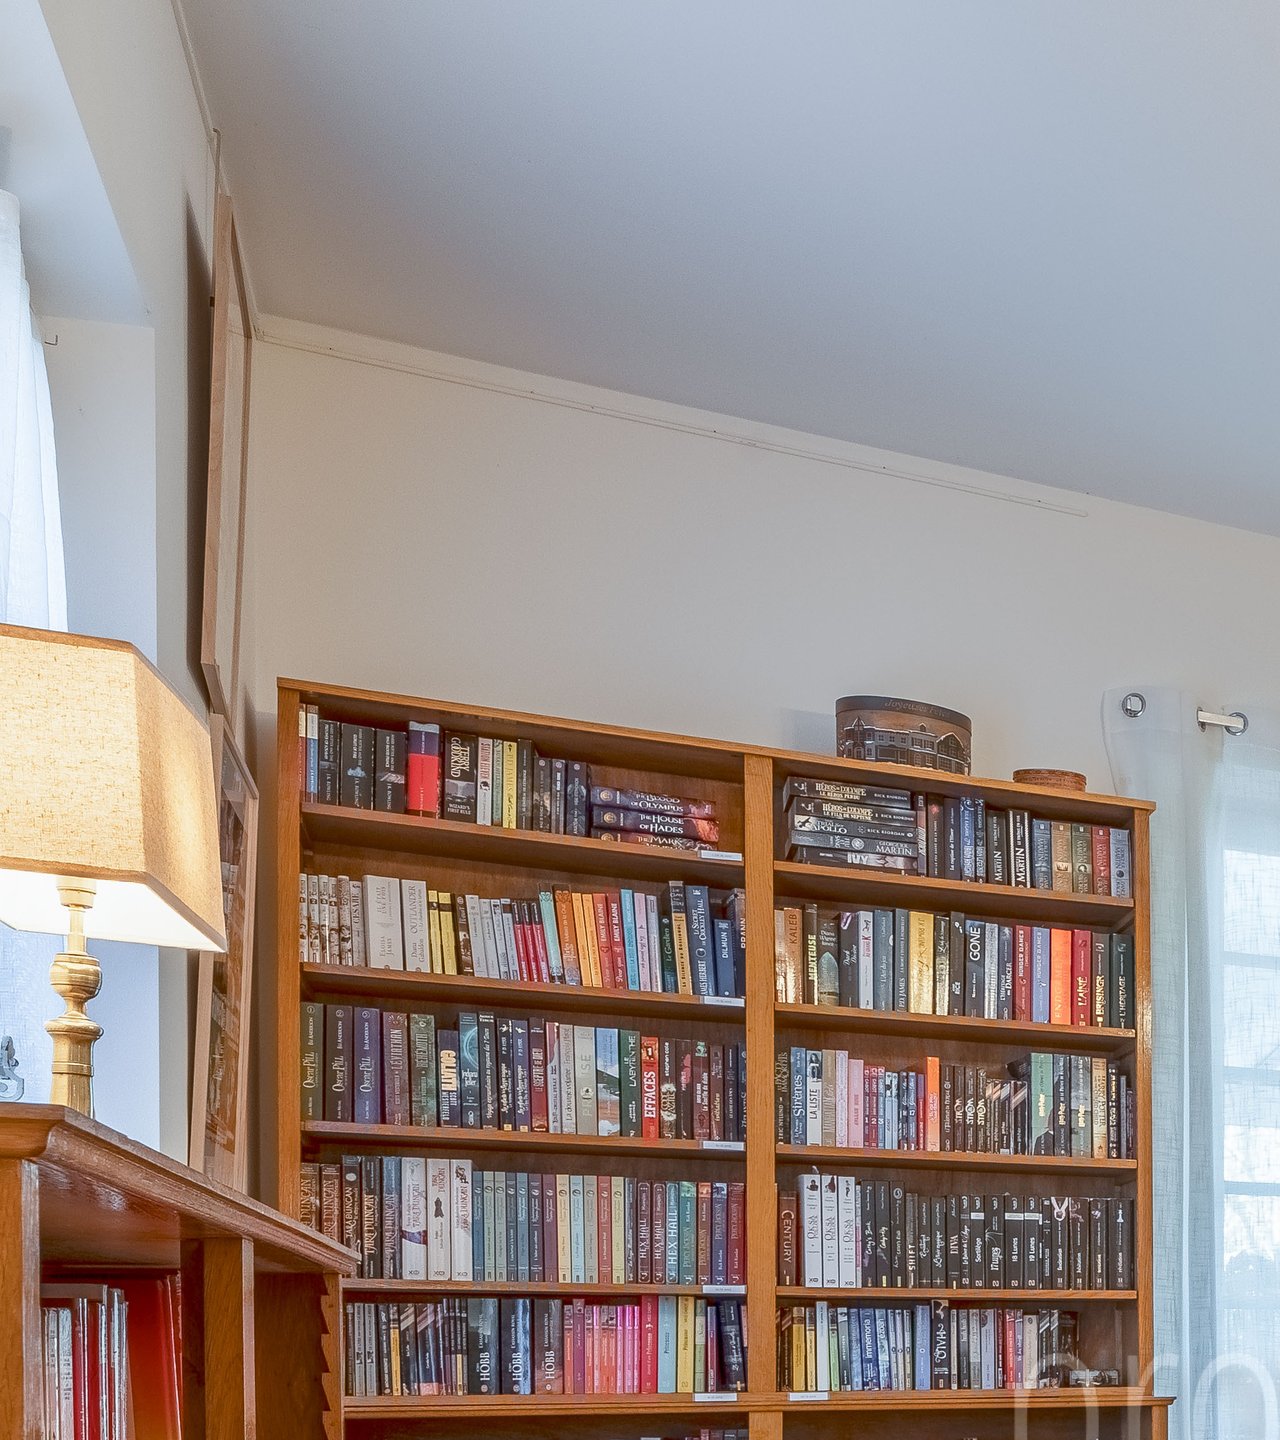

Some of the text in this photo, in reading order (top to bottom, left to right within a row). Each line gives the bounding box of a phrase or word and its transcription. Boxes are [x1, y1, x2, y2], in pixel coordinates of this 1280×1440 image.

[450, 737, 461, 778] GOODKIND
[460, 746, 470, 772] TERRY
[480, 763, 490, 779] ELEVEN
[638, 801, 684, 812] OLYMPUS
[639, 813, 685, 826] THE HOUSE
[650, 823, 684, 835] HADES
[650, 836, 684, 846] MARK
[811, 825, 848, 835] APOLLO
[847, 852, 869, 864] IVY
[876, 845, 912, 856] MARTIN
[993, 850, 1002, 880] MARTIN
[1015, 847, 1025, 882] MARTIN
[352, 893, 360, 924] CESARE
[408, 885, 418, 935] OUTLANDER
[611, 903, 619, 924] BLAINE
[696, 899, 705, 914] HALL
[597, 903, 607, 942] EMILY BLAINE
[788, 914, 797, 944] KALEB
[663, 928, 671, 955] Gardien
[720, 932, 729, 959] DILMUN
[969, 927, 981, 961] GONE
[697, 960, 707, 982] HERBERT
[808, 934, 817, 980] MENTEUSE
[898, 977, 906, 997] JAMES
[1096, 975, 1104, 1015] BRISINGR
[440, 1049, 457, 1091] GOLIATH
[532, 1048, 544, 1087] SCEPTRE DIEU
[628, 1036, 637, 1087] LABYRINTHE
[792, 1075, 805, 1117] Sirènes
[809, 1089, 818, 1109] LISTE
[364, 1193, 377, 1255] TARA DUNCAN
[666, 1210, 677, 1265] HEX HALL
[781, 1210, 794, 1263] CENTURY
[807, 1216, 815, 1240] OKSA
[843, 1219, 851, 1243] OKSA
[639, 1219, 647, 1259] HEX HALL
[653, 1219, 663, 1259] HEX HALL
[950, 1234, 959, 1254] DIVA
[974, 1238, 982, 1263] Sortilège
[862, 1319, 873, 1359] immemoria
[480, 1352, 491, 1381] HOBB
[512, 1352, 522, 1381] HOBB
[545, 1350, 555, 1379] HOBB
